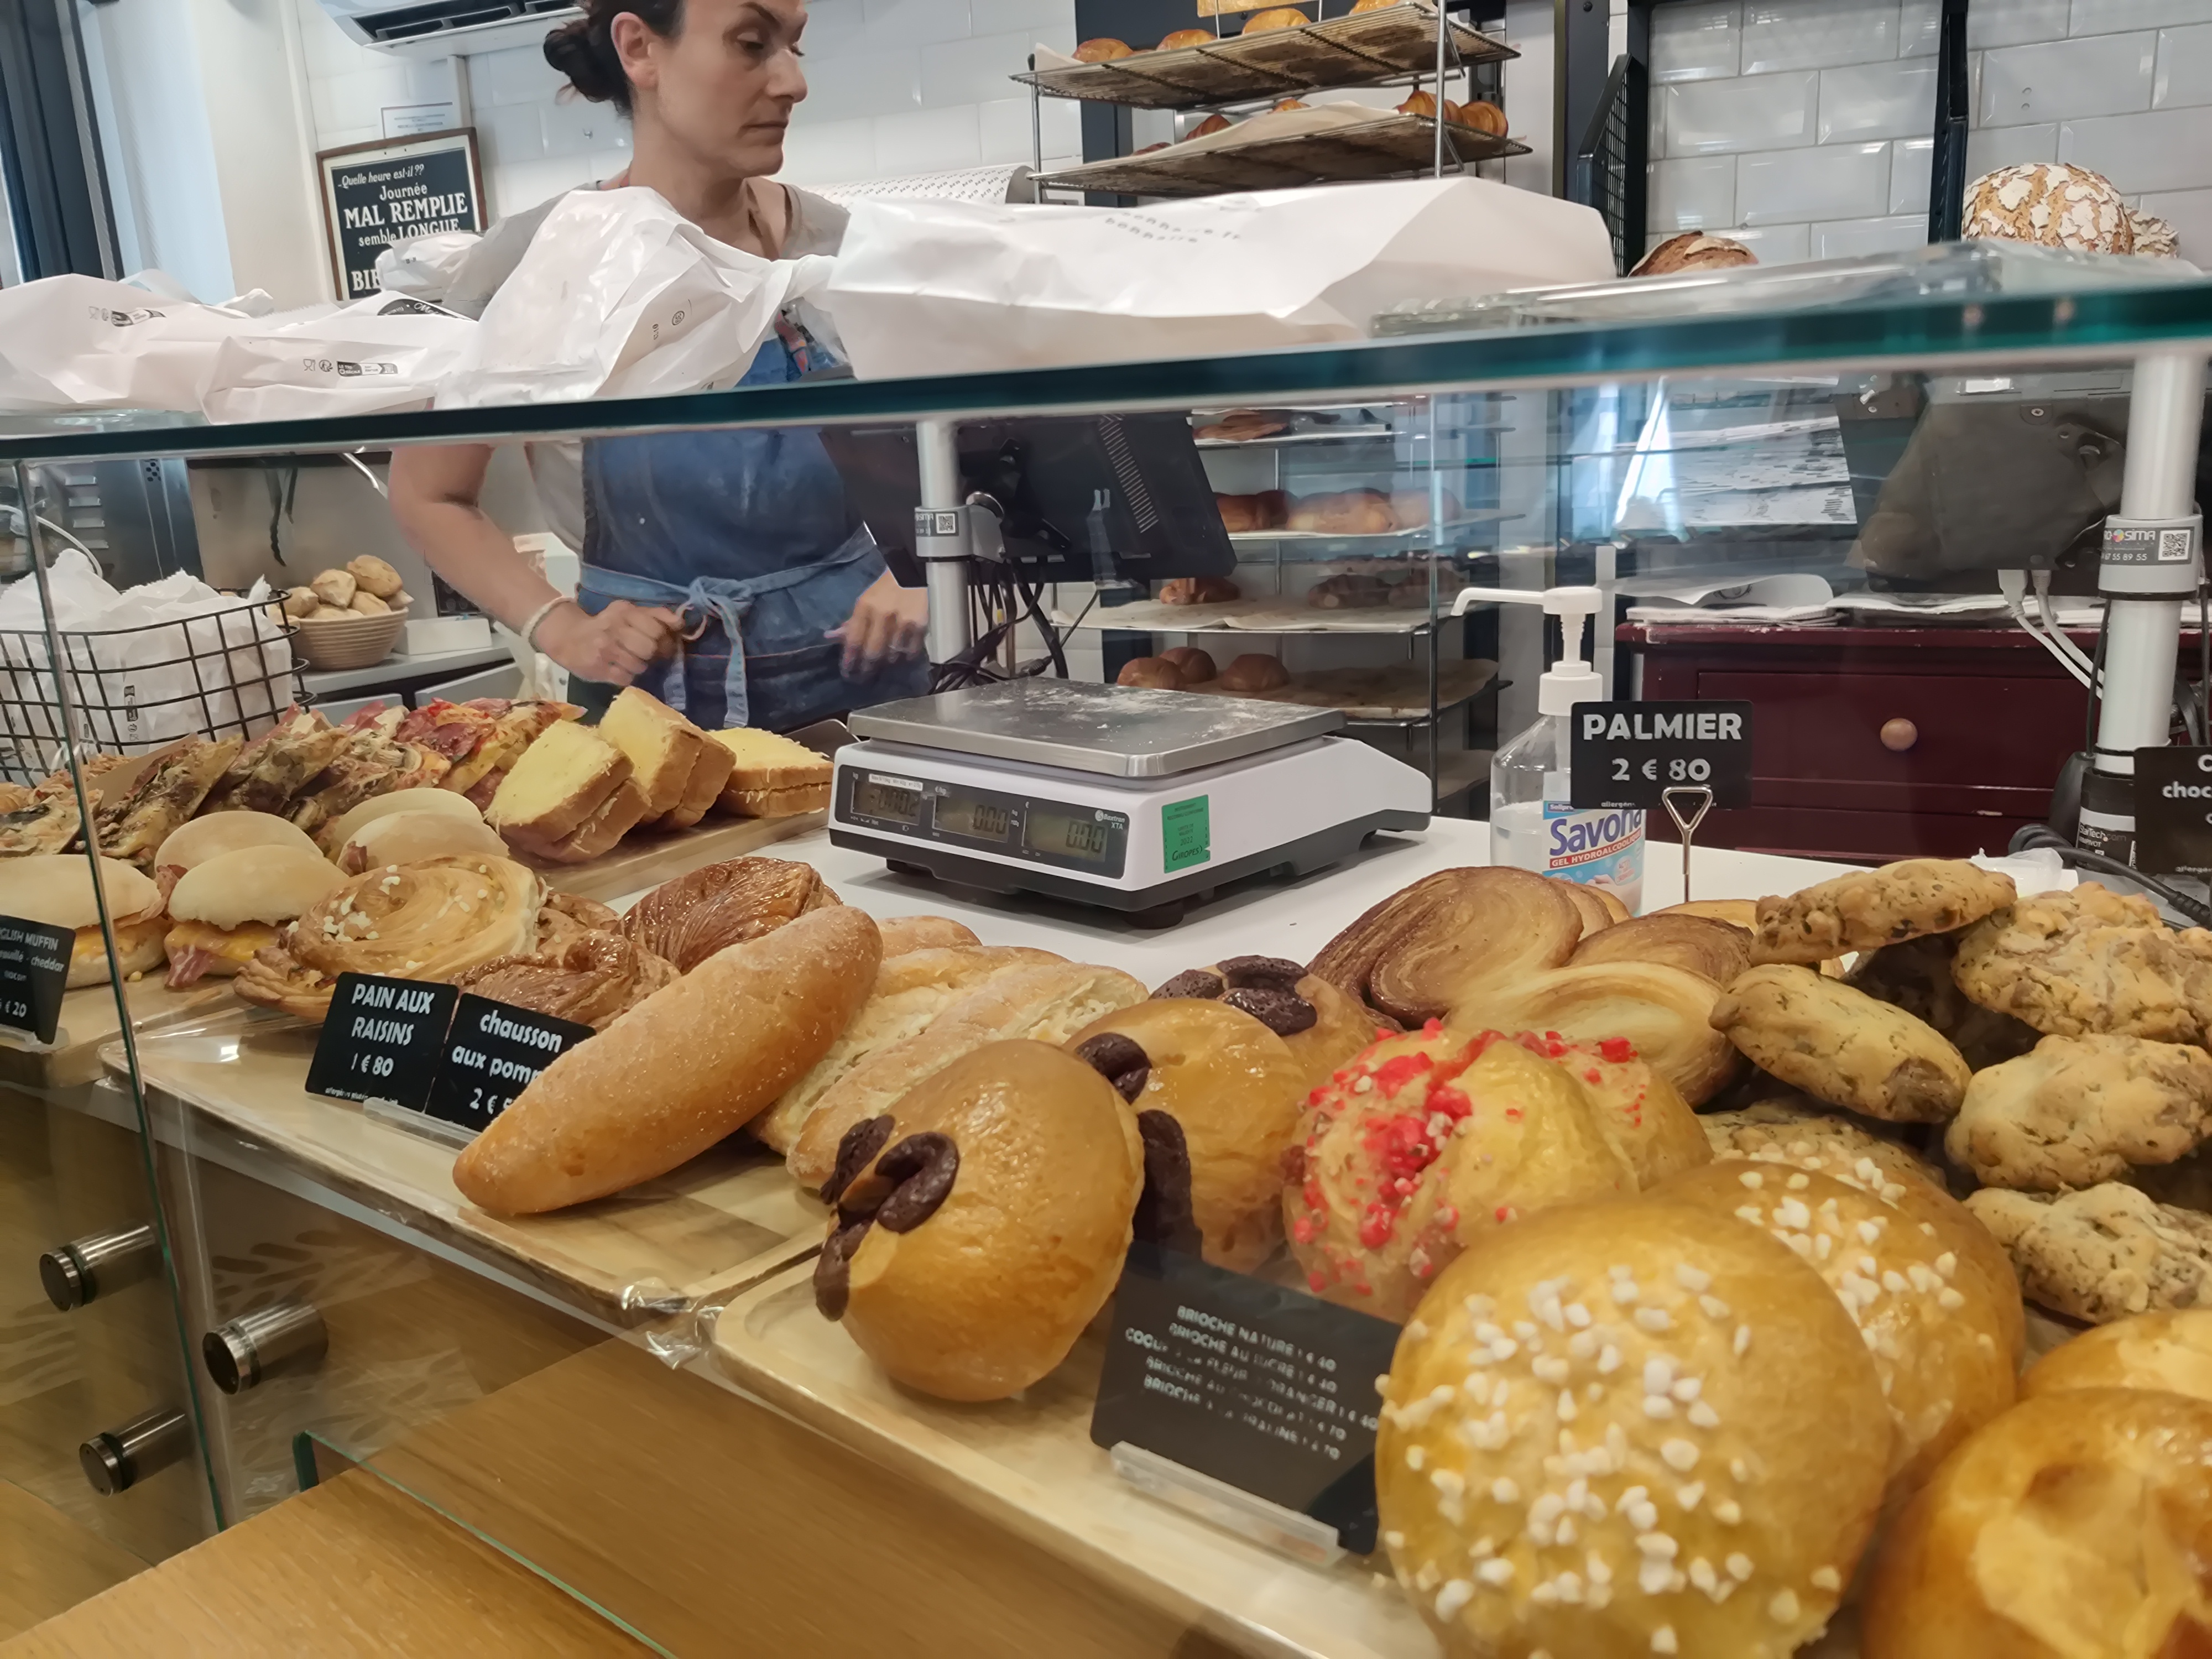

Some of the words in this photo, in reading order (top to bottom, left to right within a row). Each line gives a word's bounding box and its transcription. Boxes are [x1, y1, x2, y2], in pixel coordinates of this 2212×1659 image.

[368, 171, 391, 182] heure
[379, 182, 427, 201] Journée
[343, 205, 385, 230] MAL
[389, 192, 468, 223] REMPLIE
[358, 228, 397, 247] semble
[1583, 712, 1742, 740] PALMIER
[1611, 757, 1630, 781] 2
[1641, 758, 1657, 781] €
[1668, 758, 1712, 782] 80
[1110, 822, 1124, 831] XTA
[1180, 836, 1193, 847] 2022
[1551, 858, 1569, 867] GEL
[24, 932, 59, 951] MUFFIN
[30, 955, 65, 973] cheddar
[12, 1001, 27, 1018] 20
[351, 983, 396, 1009] PAIN
[395, 989, 436, 1015] AUX
[351, 1016, 415, 1046] RAISINS
[479, 1009, 563, 1053] chausson
[351, 1052, 358, 1071] 1
[361, 1054, 372, 1074] €
[372, 1055, 395, 1077] 80
[451, 1045, 487, 1070] aux
[469, 1087, 483, 1110] 2
[487, 1095, 498, 1115] €
[1168, 1322, 1228, 1355] BRIOCHE
[1230, 1345, 1249, 1363] AU
[1177, 1305, 1237, 1338] BRIOCHE
[1239, 1326, 1295, 1357] NATURE
[1144, 1374, 1201, 1405] BRIOCHE
